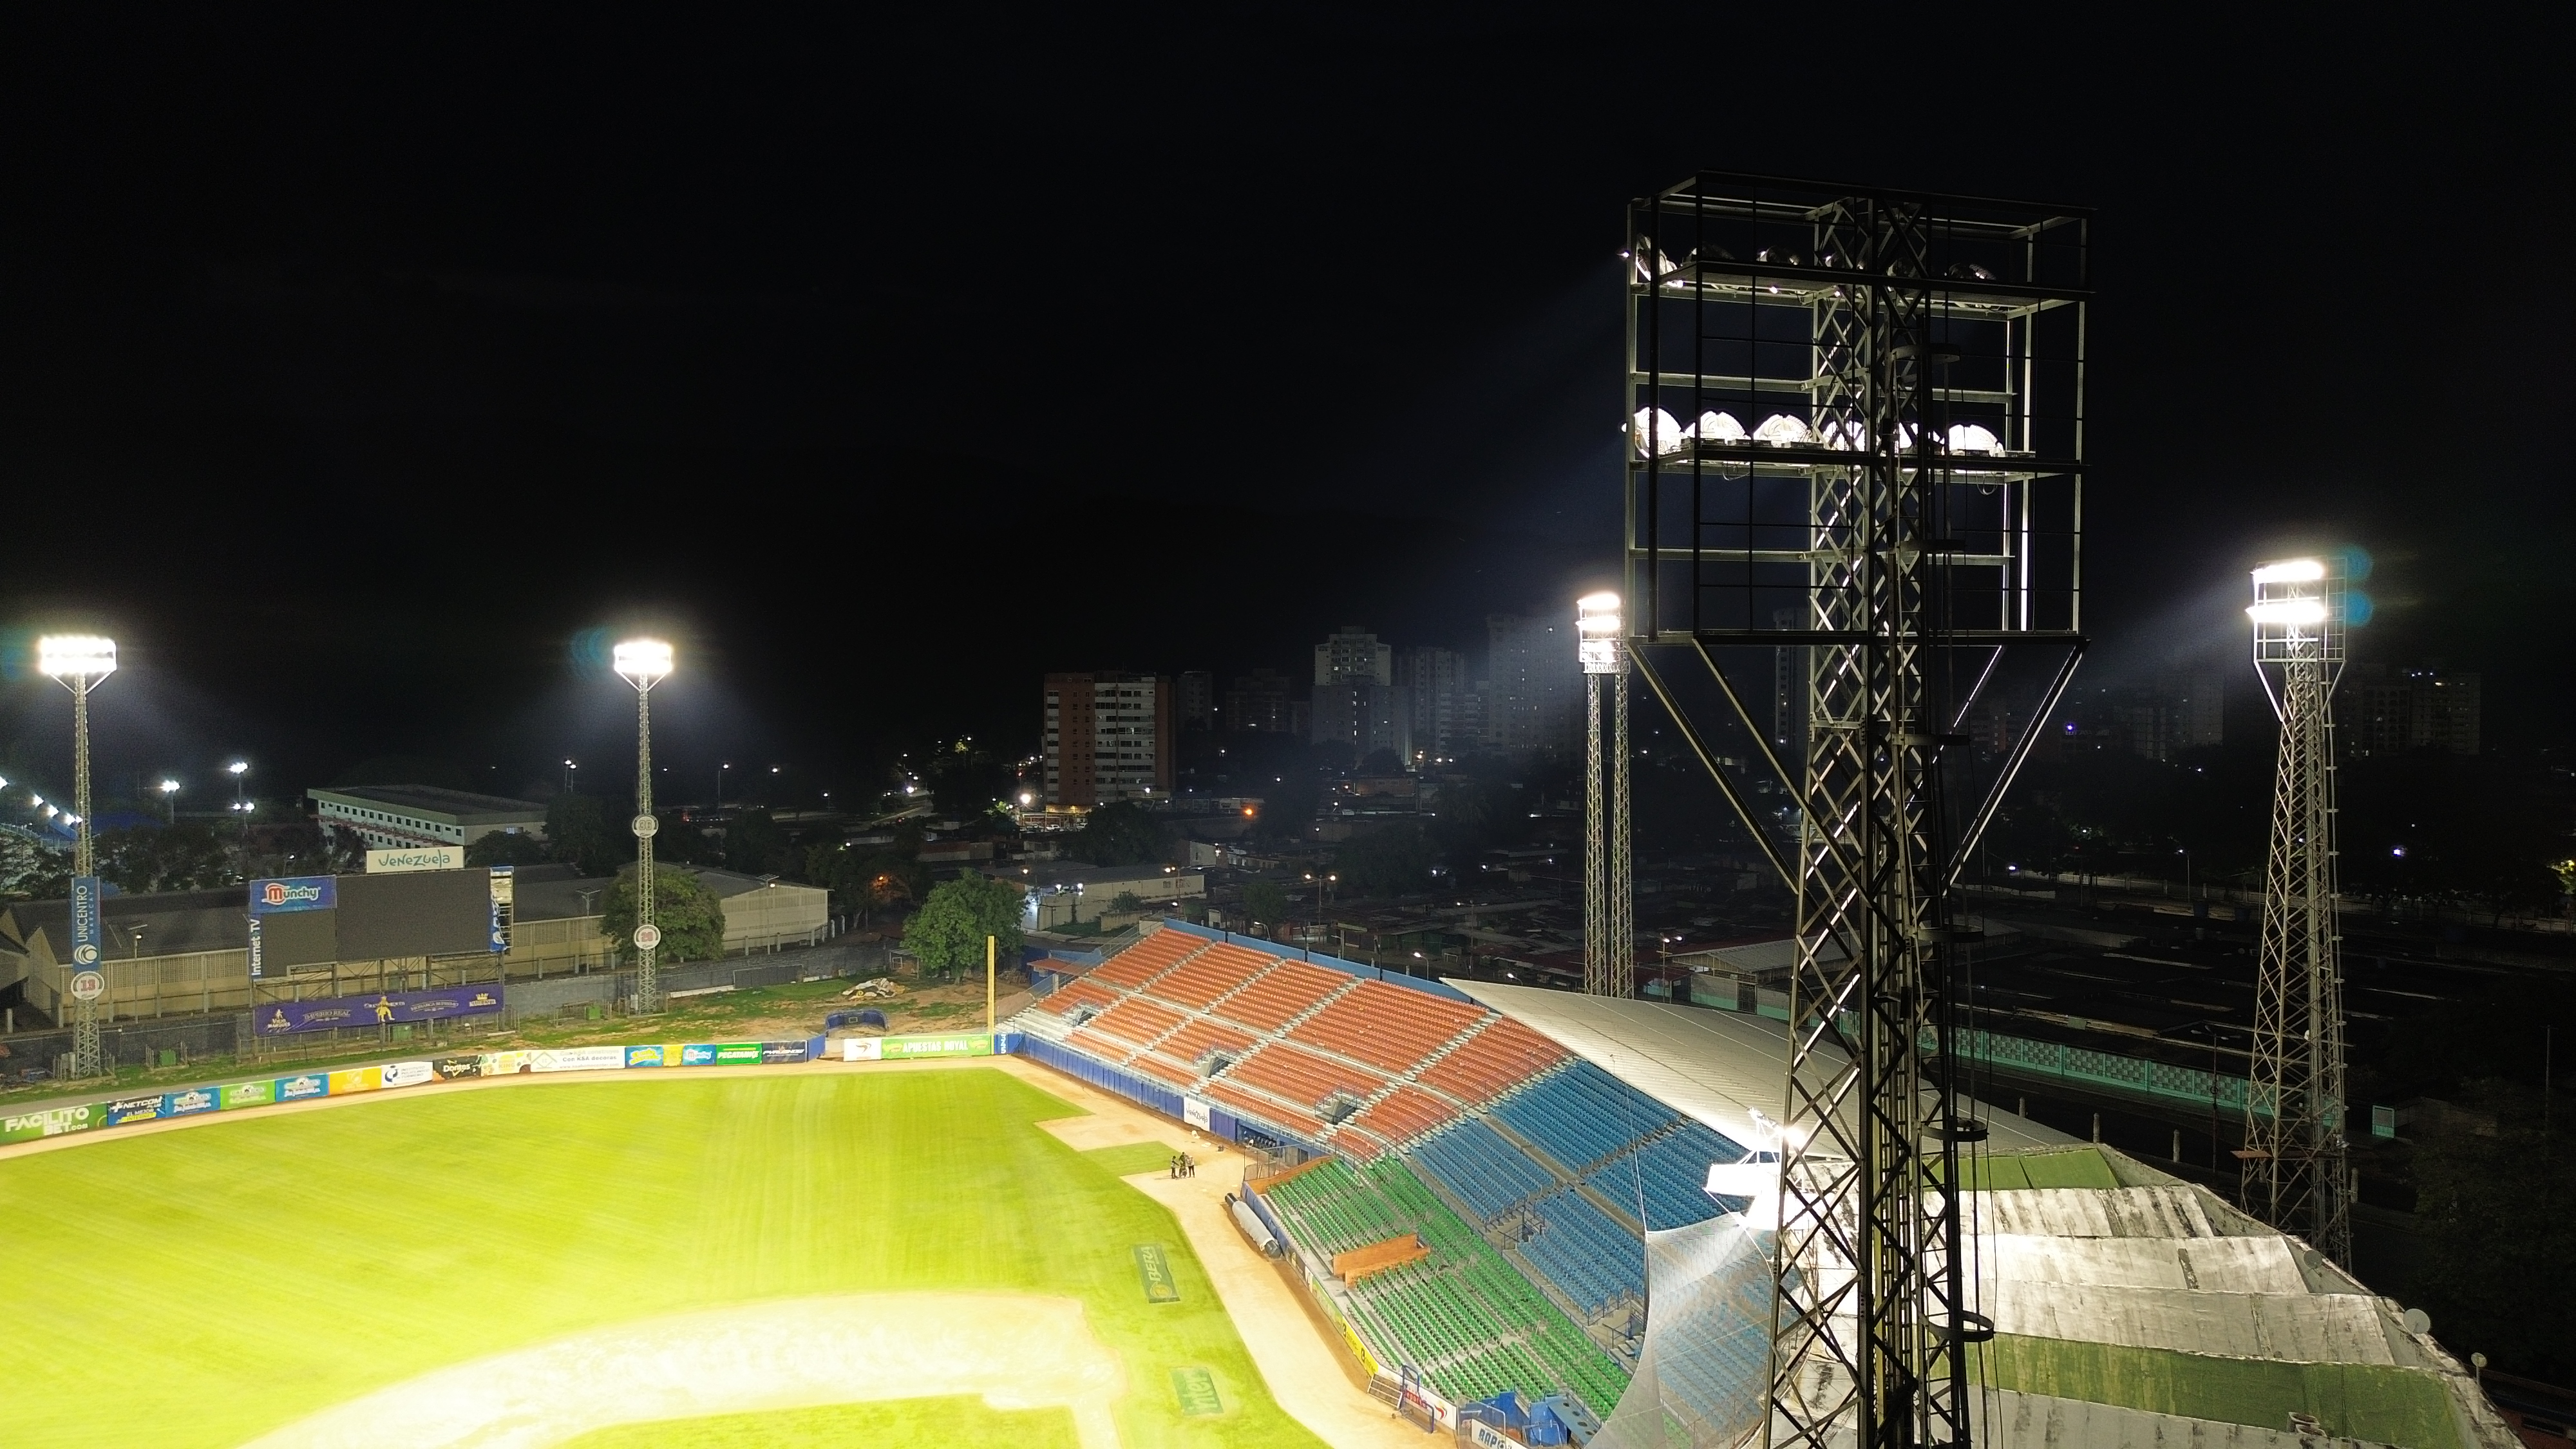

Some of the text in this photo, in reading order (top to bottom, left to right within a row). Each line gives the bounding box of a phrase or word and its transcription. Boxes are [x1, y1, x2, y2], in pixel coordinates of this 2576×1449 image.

[265, 883, 318, 904] Munchy
[77, 886, 88, 942] UNICENTRO
[80, 979, 96, 992] 13
[902, 1039, 969, 1053] APUESTAS ROYAL
[443, 1063, 471, 1072] Doritos
[123, 1095, 162, 1109] NETCOM
[5, 1108, 90, 1132] FACILITO
